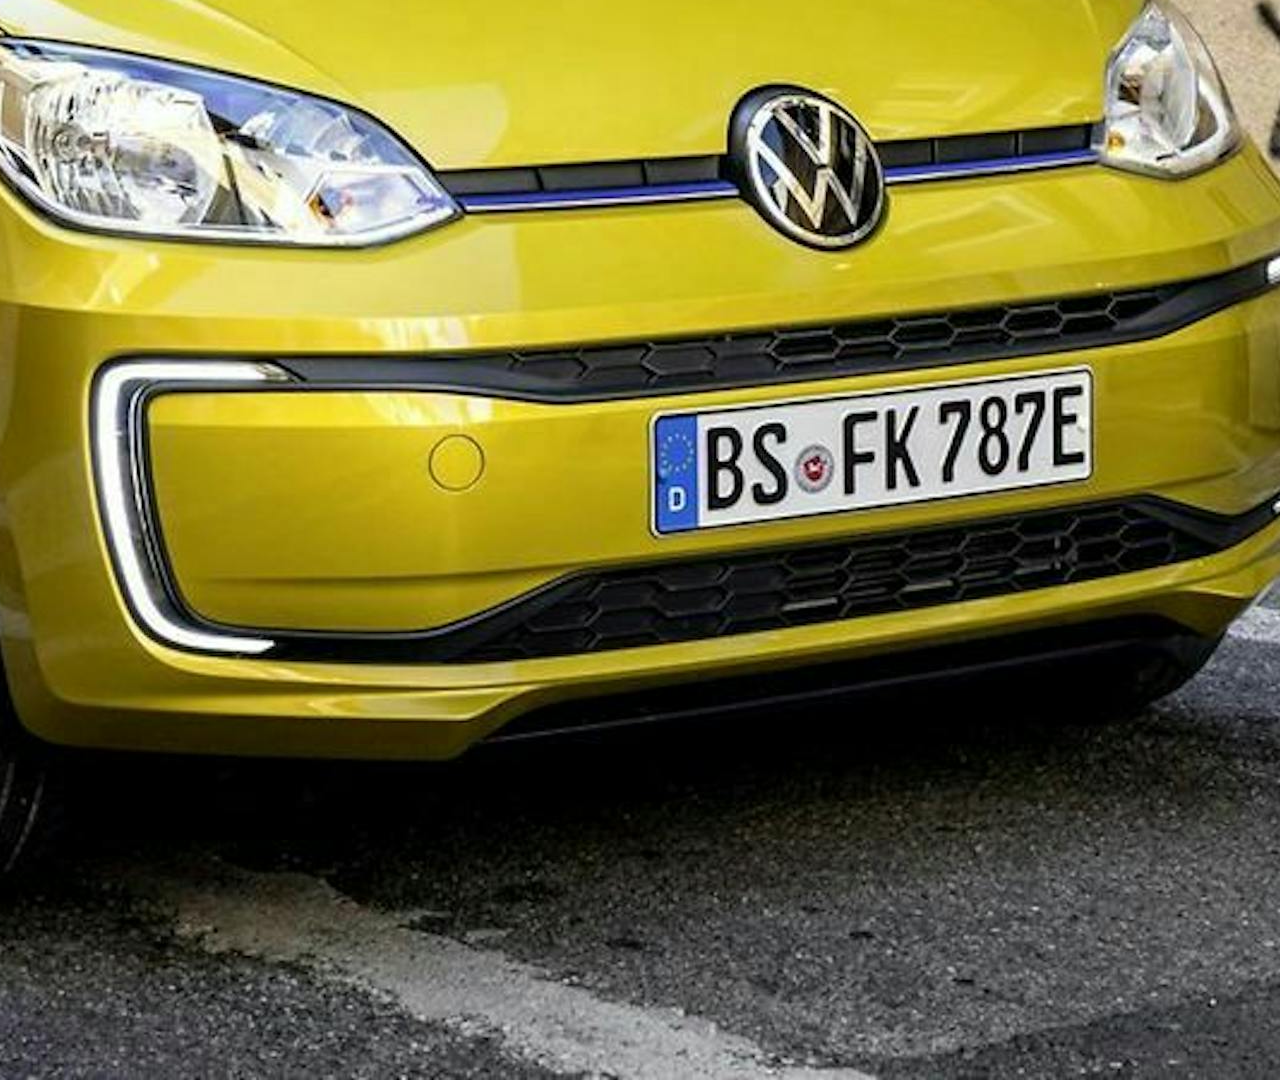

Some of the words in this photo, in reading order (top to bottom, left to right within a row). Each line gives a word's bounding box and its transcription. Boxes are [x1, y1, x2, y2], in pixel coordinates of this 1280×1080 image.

[748, 95, 883, 247] VW
[668, 486, 686, 512] D
[706, 422, 788, 511] BS
[843, 406, 920, 495] FK
[939, 385, 1085, 483] 787E
